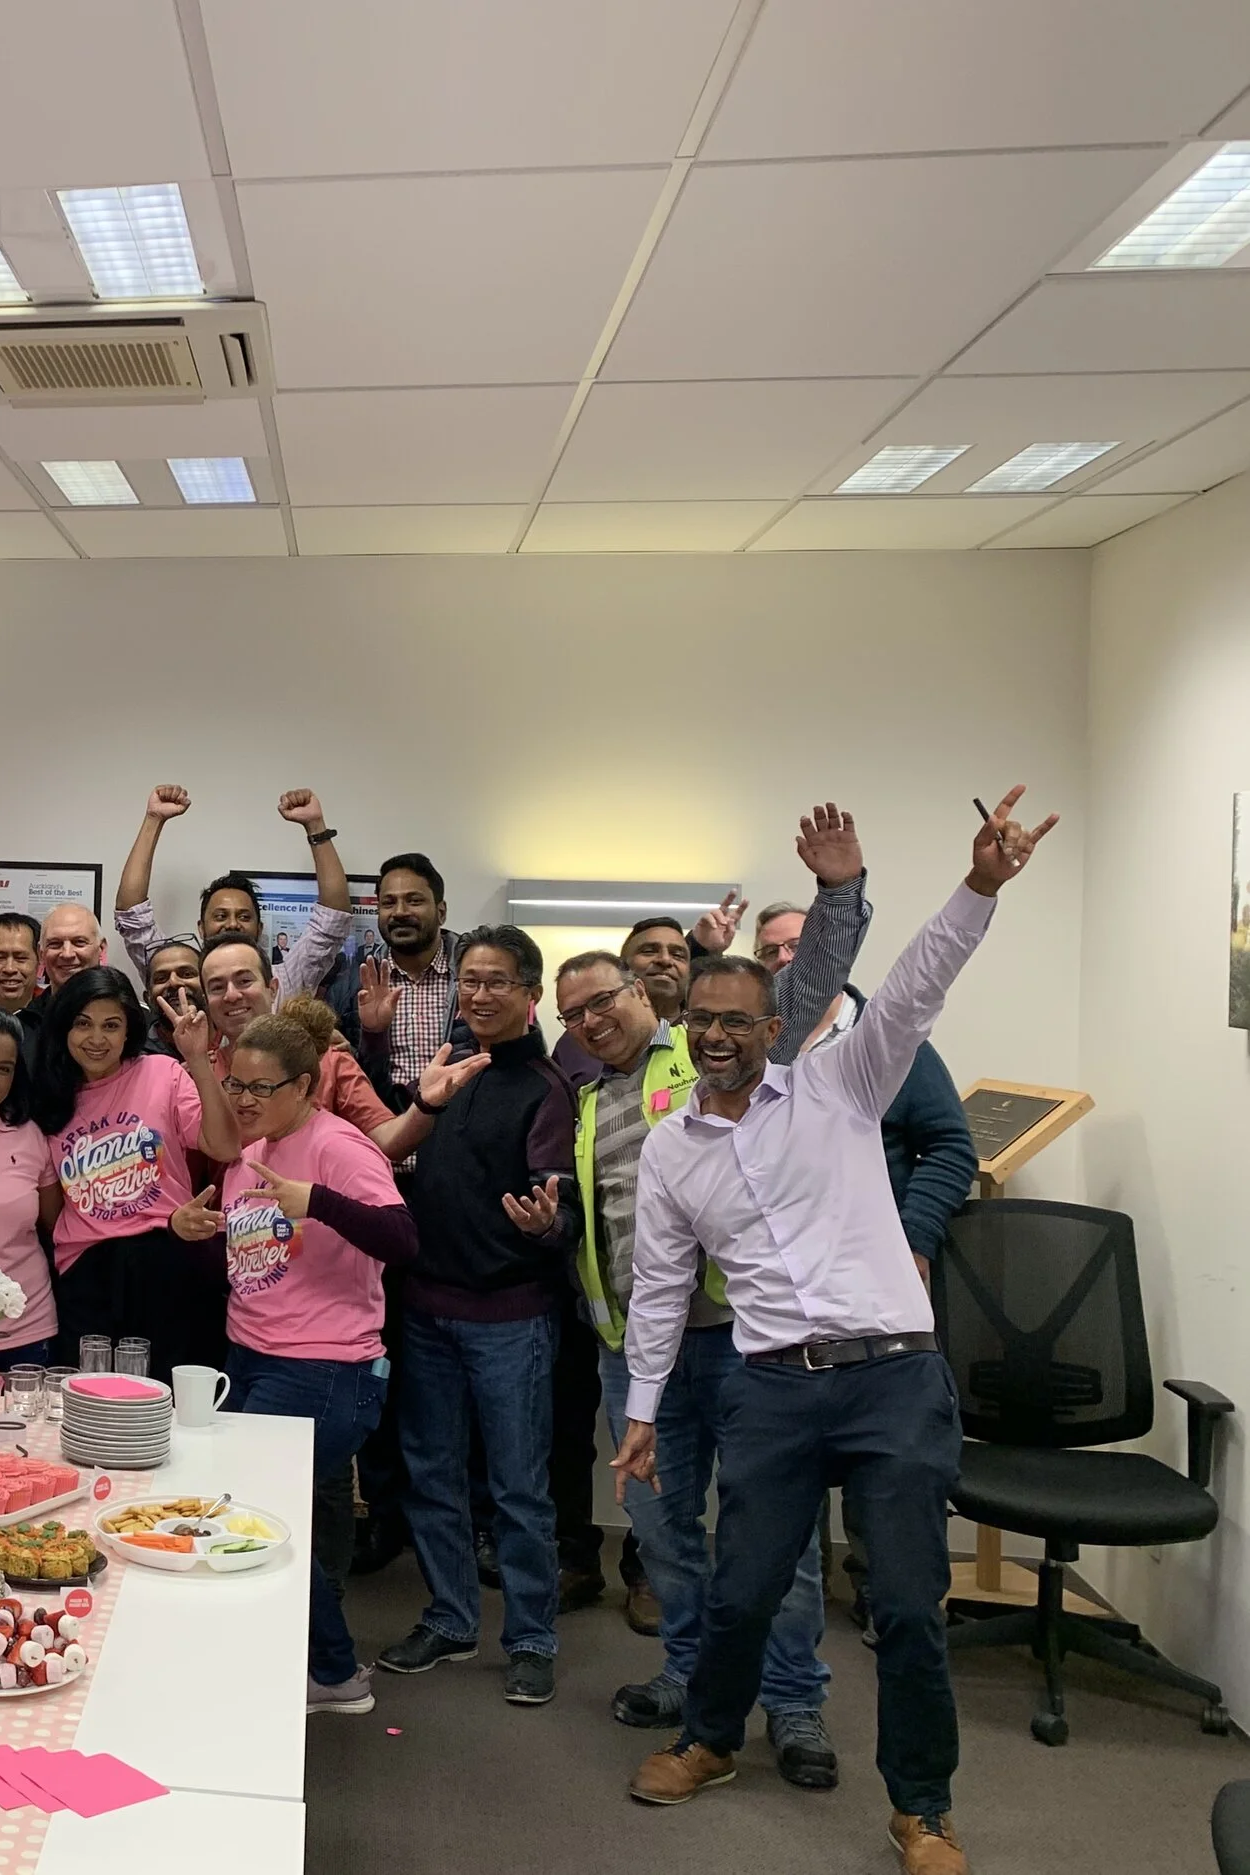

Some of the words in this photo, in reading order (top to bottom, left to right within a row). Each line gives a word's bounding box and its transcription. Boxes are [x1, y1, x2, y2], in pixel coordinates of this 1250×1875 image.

[258, 903, 297, 912] cellence
[60, 1120, 144, 1185] Stand
[61, 1115, 110, 1154] SPEAK
[116, 1111, 140, 1126] UP
[79, 1164, 161, 1214] Together
[89, 1206, 117, 1220] STOP
